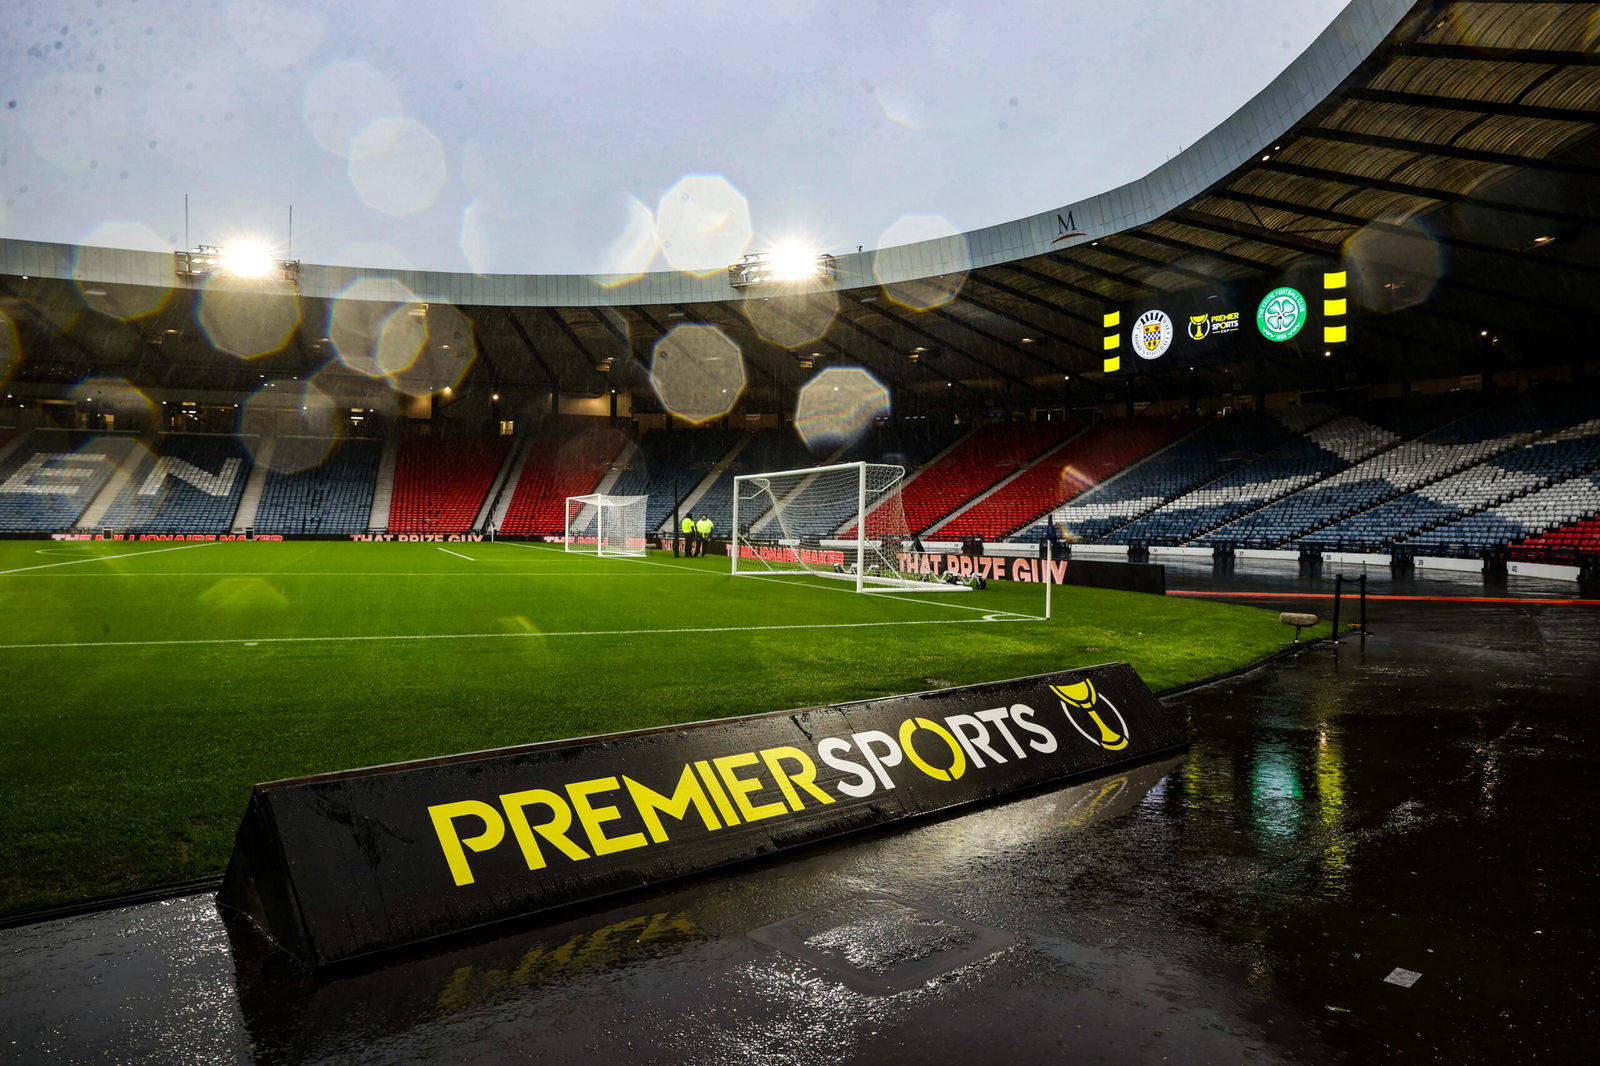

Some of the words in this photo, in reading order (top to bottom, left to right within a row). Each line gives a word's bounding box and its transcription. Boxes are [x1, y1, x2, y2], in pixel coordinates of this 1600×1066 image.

[1057, 210, 1078, 235] M
[1211, 312, 1240, 323] PREMIER
[1211, 320, 1239, 331] SPORTS
[896, 552, 942, 576] THAT
[946, 554, 1006, 581] PRIZE
[1012, 558, 1068, 585] GUY
